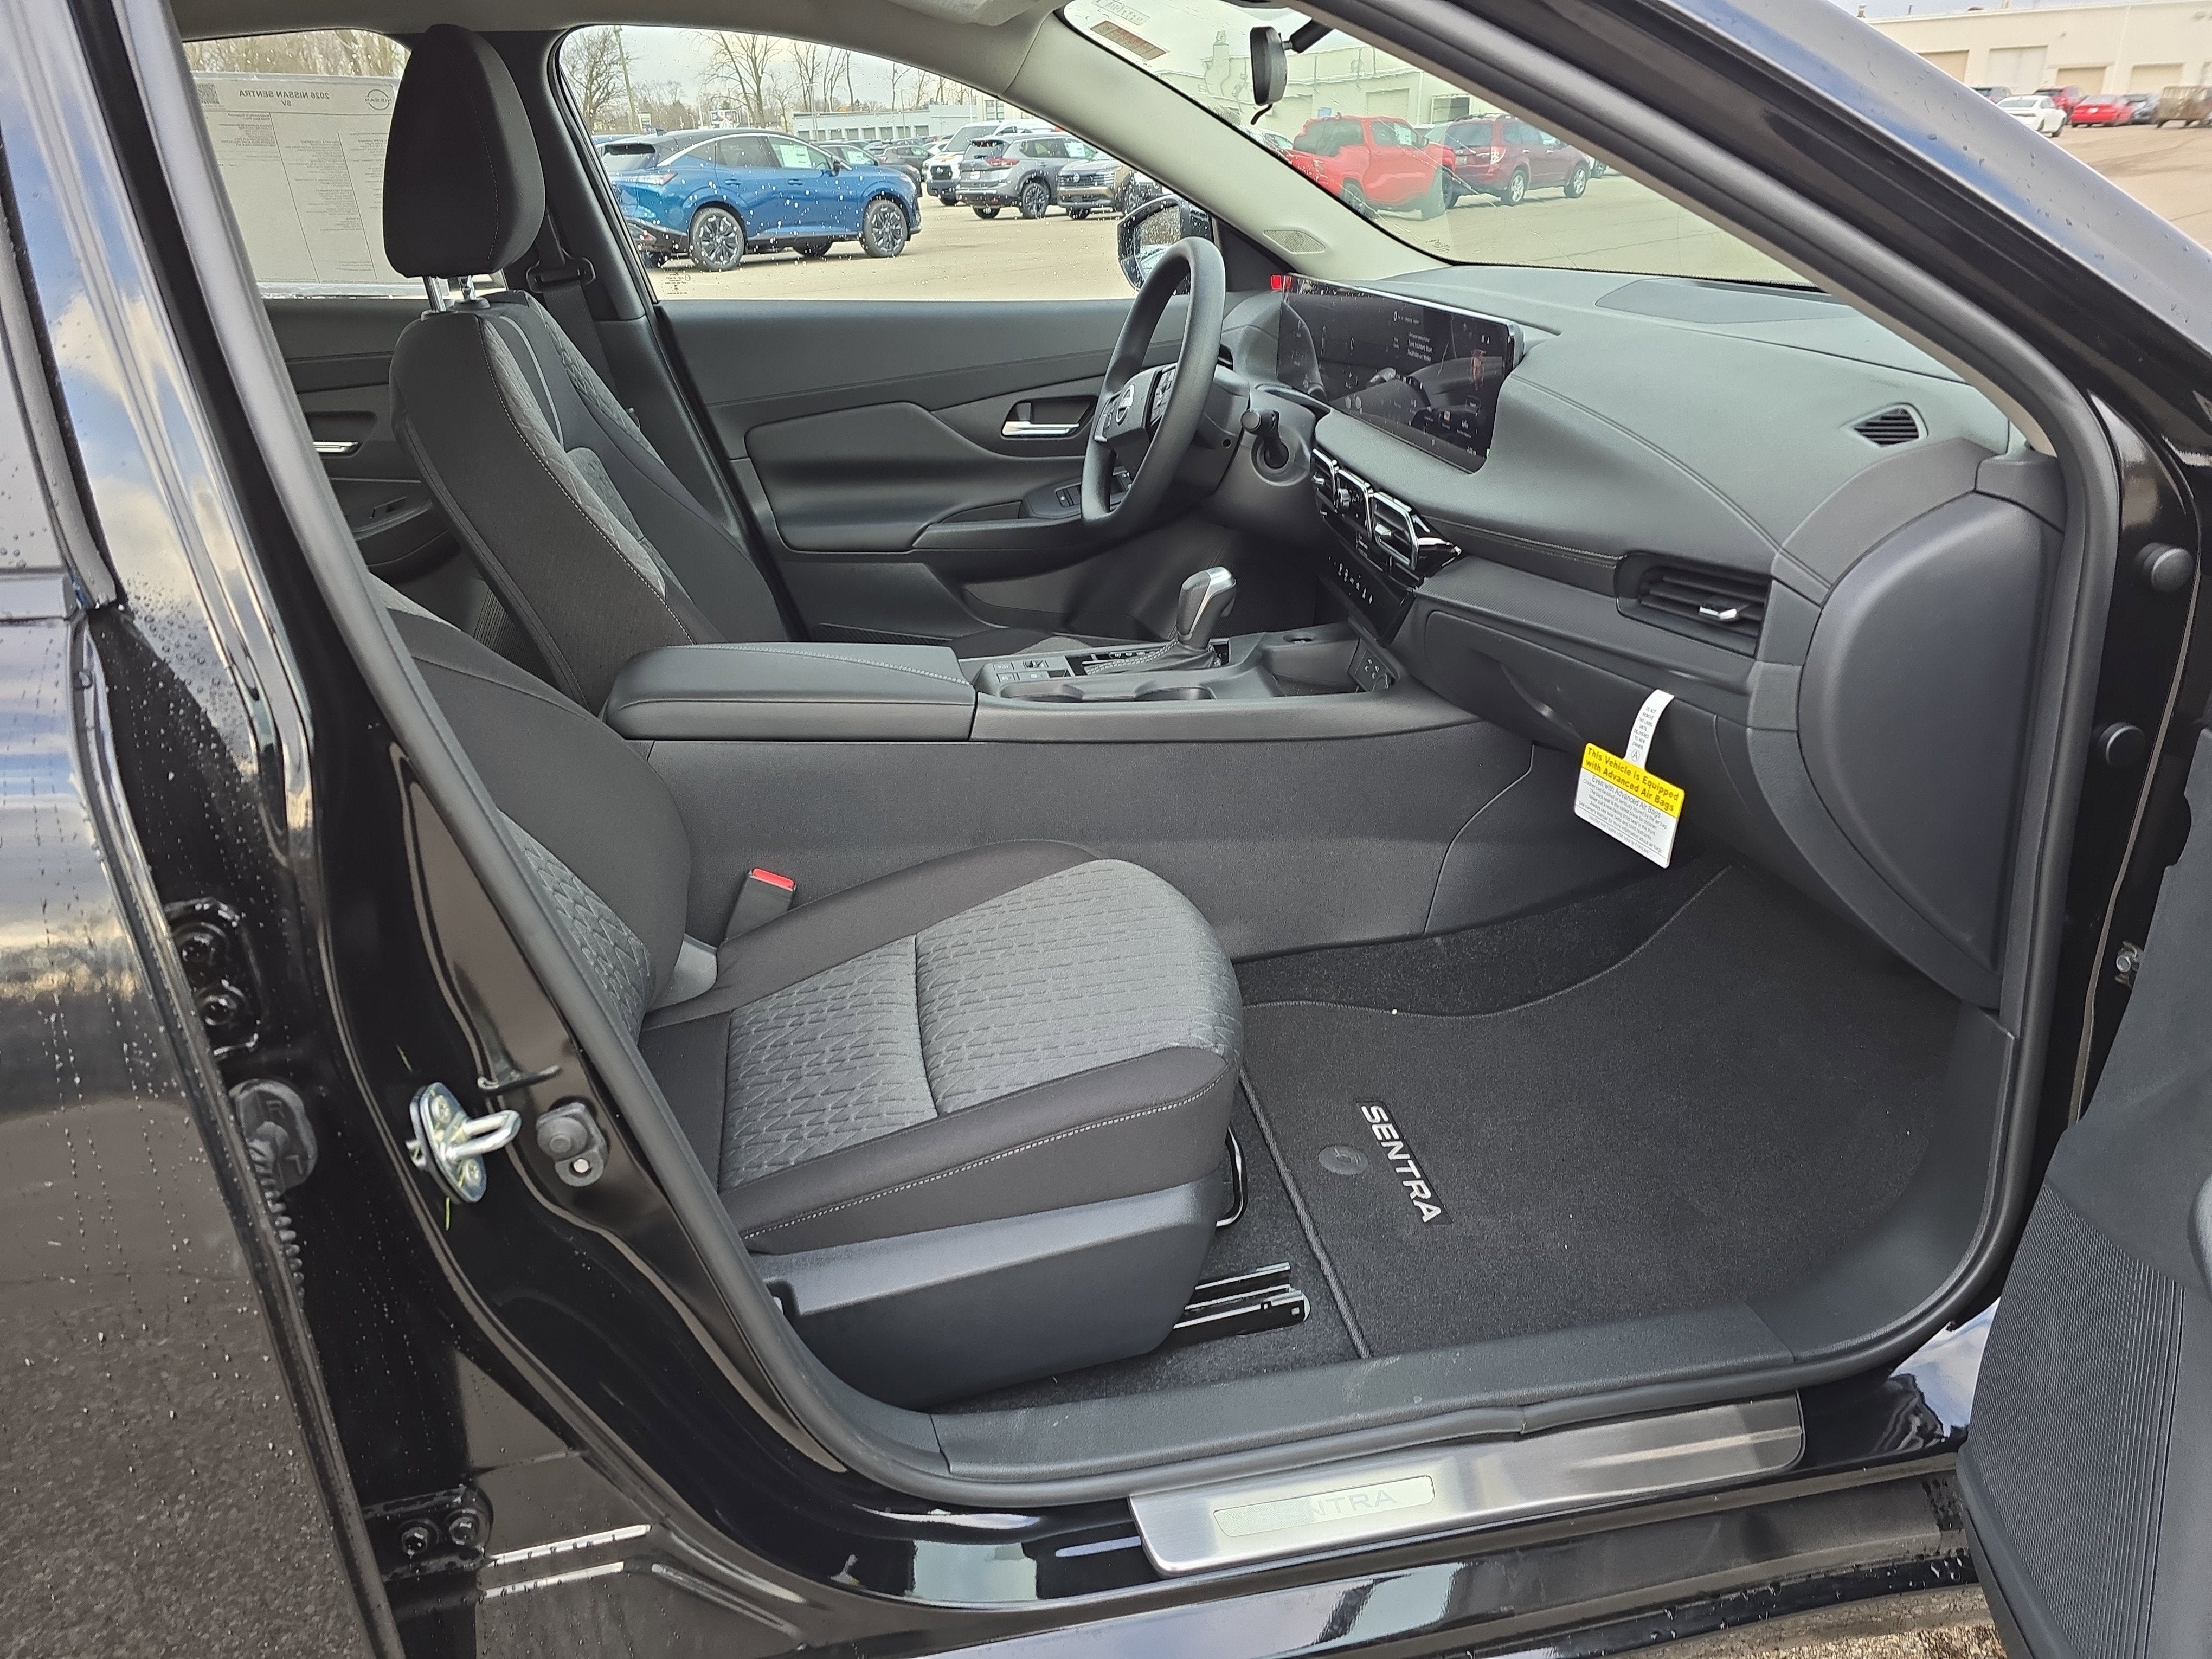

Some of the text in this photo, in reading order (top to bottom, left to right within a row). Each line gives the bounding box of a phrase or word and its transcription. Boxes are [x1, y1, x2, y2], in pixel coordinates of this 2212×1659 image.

[1586, 760, 1674, 811] with Advanced Air Bags
[1587, 748, 1679, 801] This Vehicle is Equipped
[1592, 775, 1661, 818] Even with Advanced Air Bags
[1361, 1105, 1442, 1223] SENTRA
